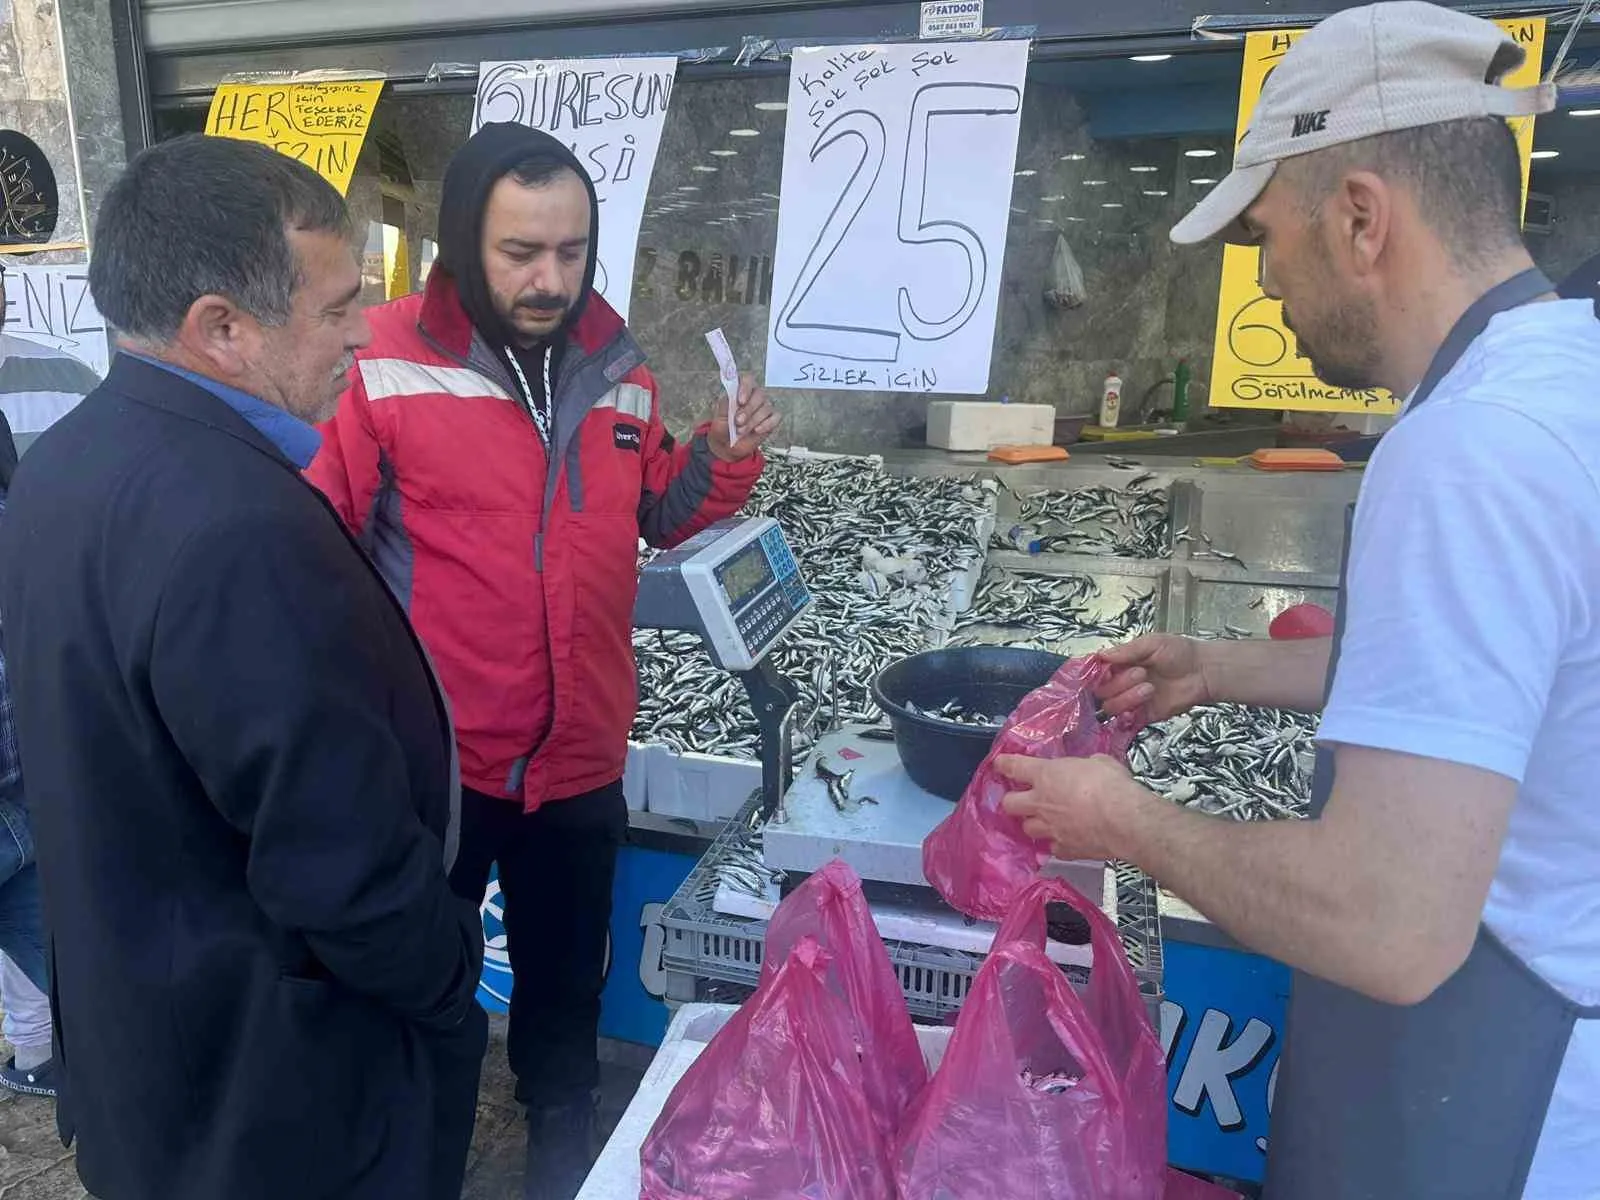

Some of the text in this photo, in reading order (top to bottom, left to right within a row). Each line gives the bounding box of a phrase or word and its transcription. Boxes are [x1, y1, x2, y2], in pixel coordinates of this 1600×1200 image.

[1507, 24, 1535, 42] İN
[798, 50, 877, 96] Kalite
[214, 91, 292, 134] HER
[475, 63, 672, 131] GİRESUN
[1291, 110, 1330, 138] NIKE
[774, 82, 1021, 363] 25
